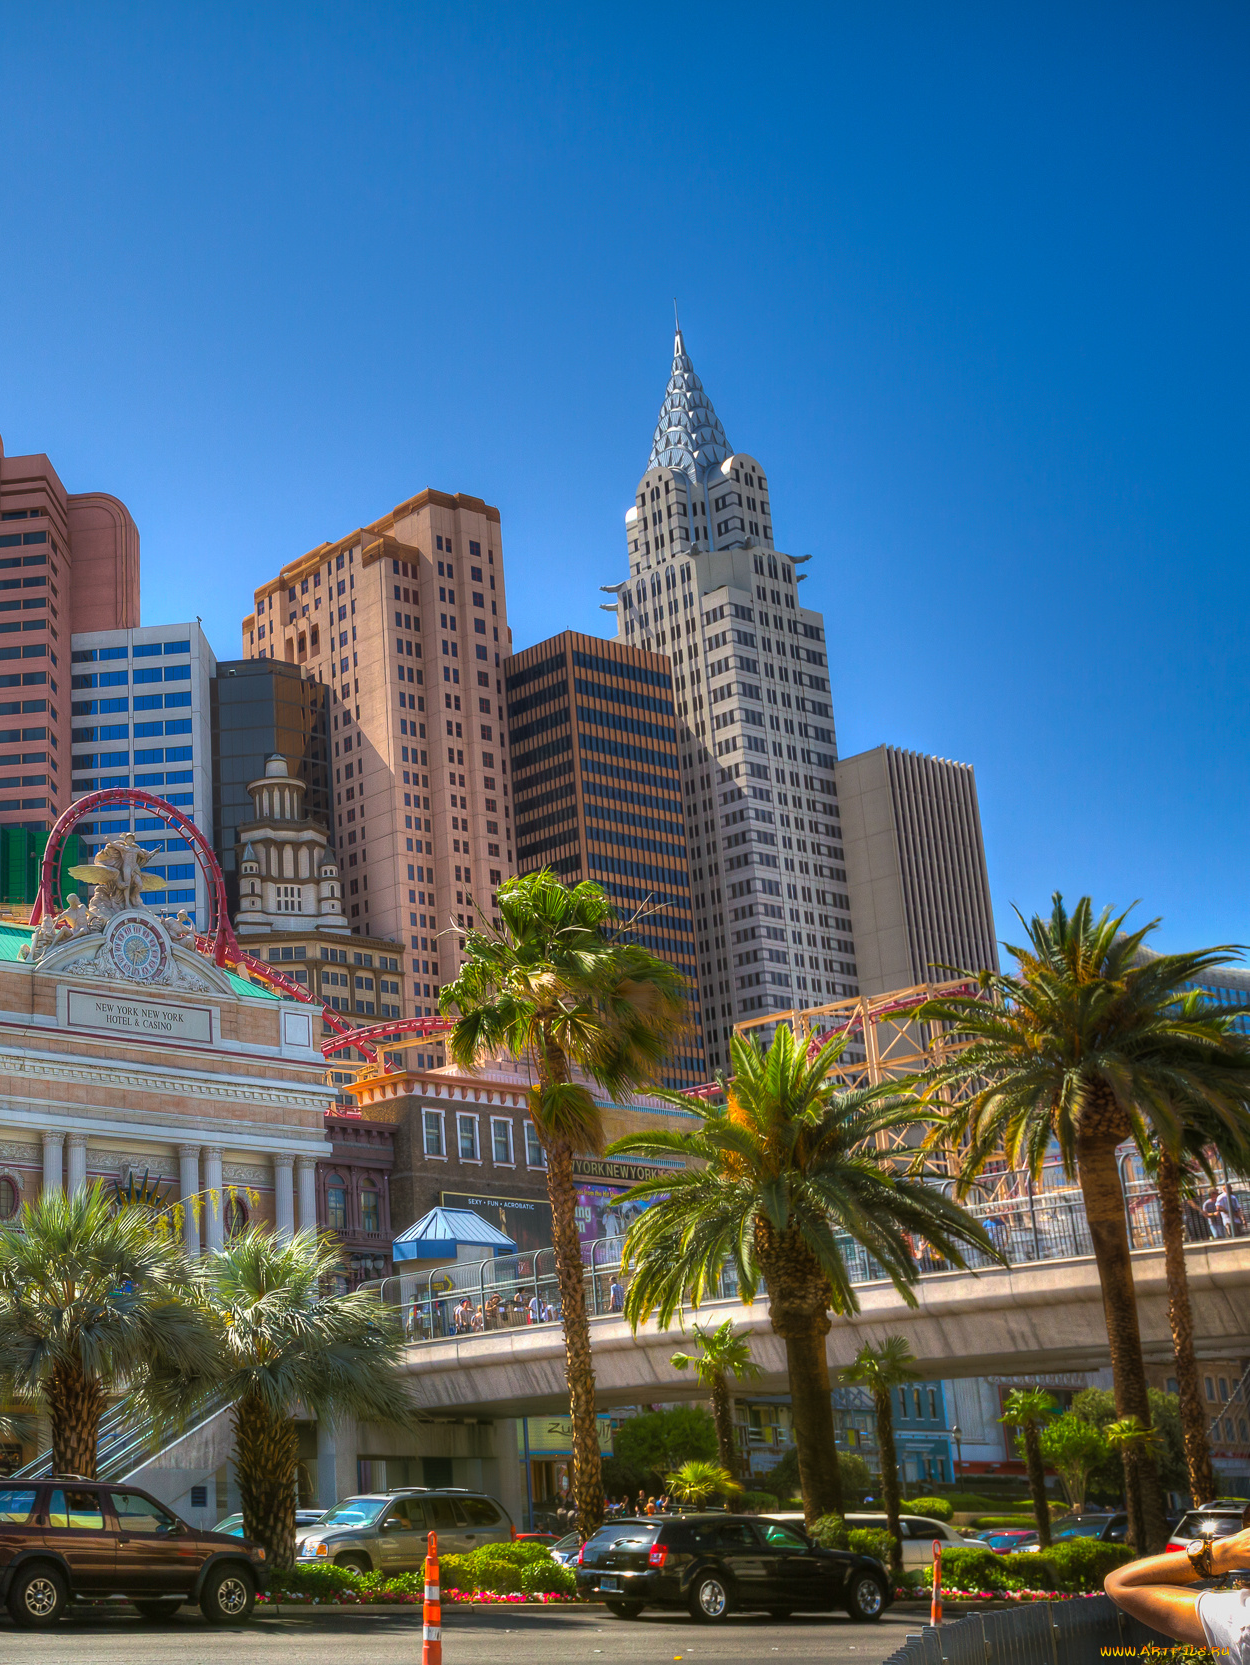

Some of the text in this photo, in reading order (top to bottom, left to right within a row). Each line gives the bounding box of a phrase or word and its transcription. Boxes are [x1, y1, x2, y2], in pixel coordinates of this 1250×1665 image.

[95, 1003, 184, 1022] NEW YORK NEW YORK
[106, 1014, 172, 1031] HOTEL & CASINO
[576, 1161, 605, 1176] YORK
[605, 1164, 629, 1178] NEW
[630, 1166, 658, 1180] YORK
[468, 1198, 482, 1206] SEXY
[504, 1202, 534, 1210] ACROBATIC
